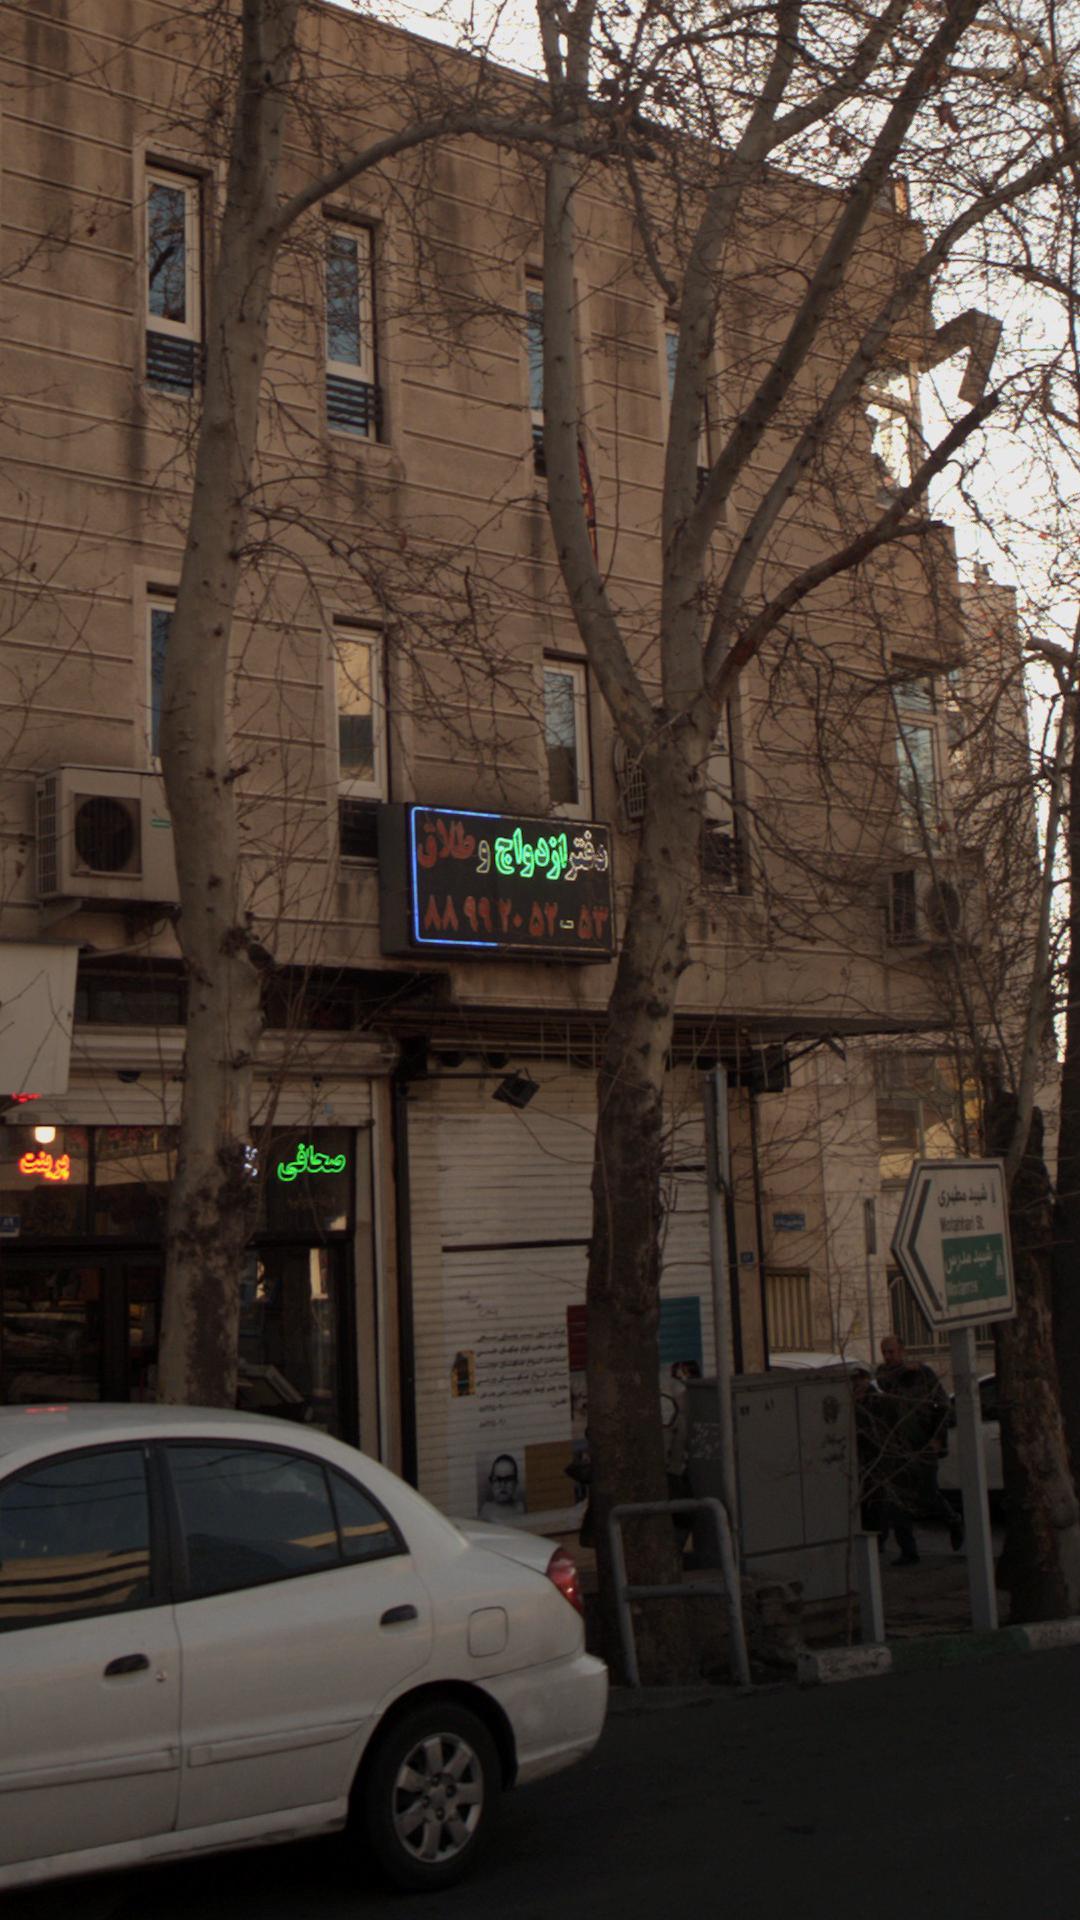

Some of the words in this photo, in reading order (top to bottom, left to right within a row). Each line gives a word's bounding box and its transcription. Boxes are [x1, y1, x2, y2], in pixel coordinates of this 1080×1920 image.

[418, 818, 476, 869] طلاق
[476, 839, 491, 874] و
[494, 826, 568, 881] ازدواج
[564, 829, 609, 881] دفتر
[19, 1150, 71, 1181] پرینت
[276, 1143, 347, 1182] صحافی
